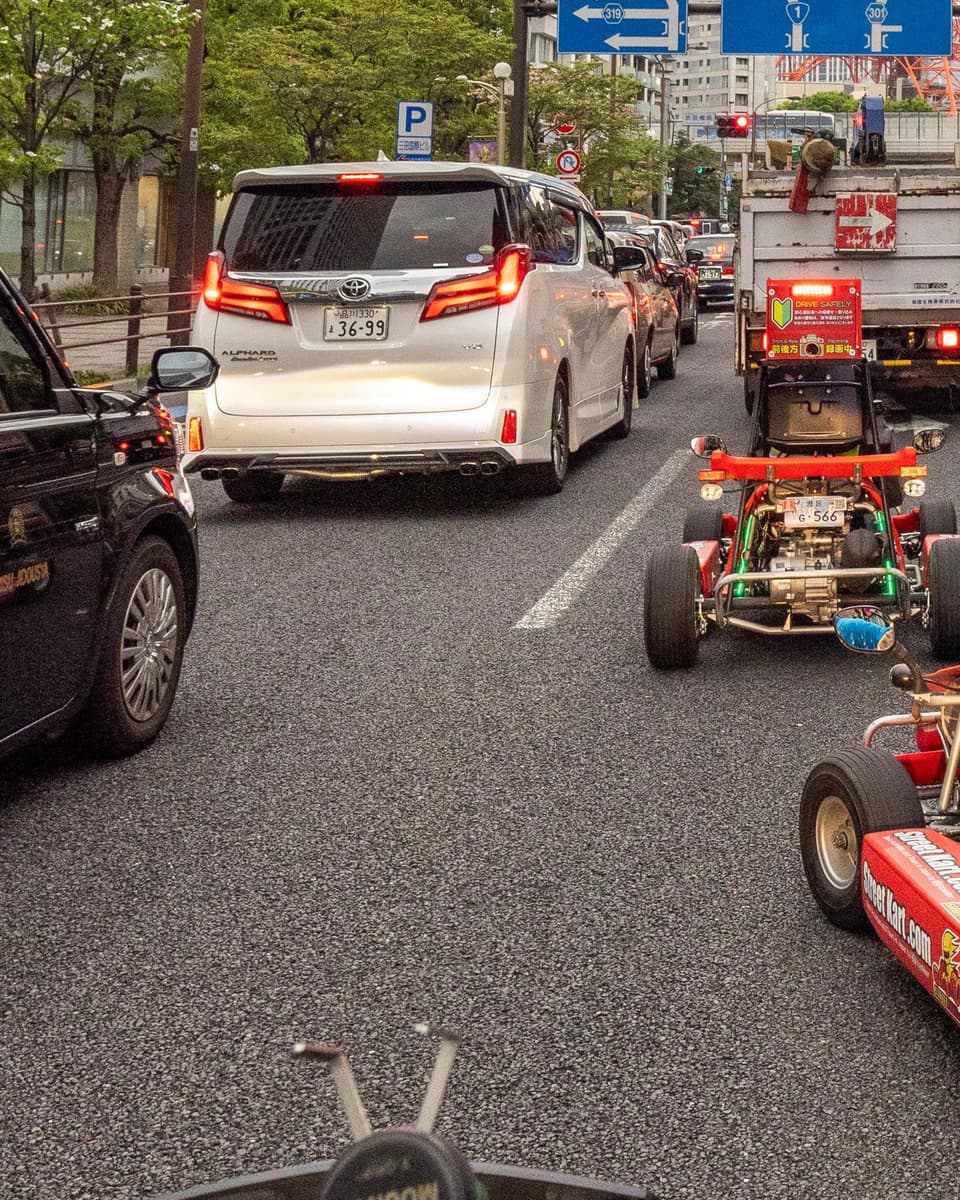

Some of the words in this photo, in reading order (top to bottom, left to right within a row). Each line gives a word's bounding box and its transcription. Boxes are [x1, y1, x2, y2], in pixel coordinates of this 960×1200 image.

[605, 8, 621, 19] 319
[795, 6, 801, 18] 1
[869, 8, 885, 19] 301
[405, 106, 427, 132] P
[338, 320, 385, 337] 36-99
[894, 831, 945, 855] Street
[863, 860, 886, 917] Street
